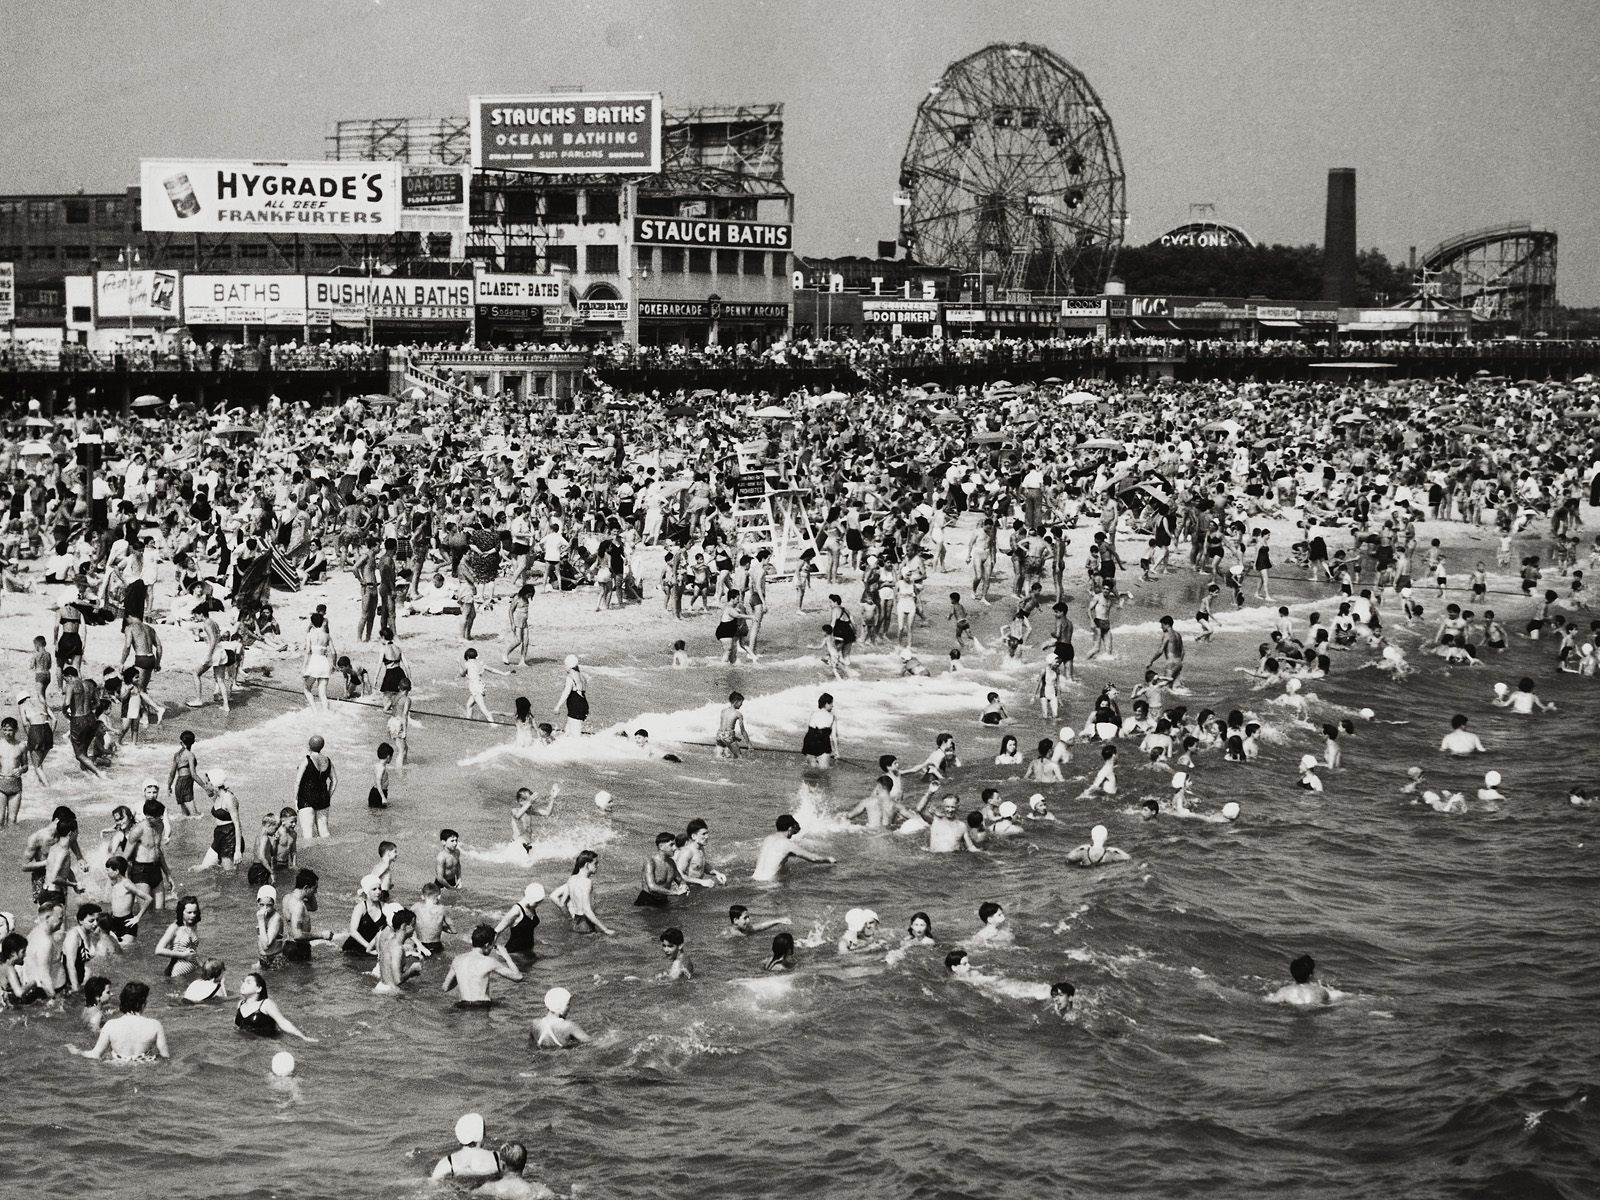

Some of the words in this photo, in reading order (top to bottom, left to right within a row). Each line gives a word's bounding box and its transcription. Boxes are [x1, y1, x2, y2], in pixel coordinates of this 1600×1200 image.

[490, 107, 576, 126] STAUCHS
[584, 105, 646, 124] BATHS
[496, 133, 553, 146] OCEAN
[563, 131, 638, 145] BATHING
[217, 171, 383, 203] HYGRADE'S
[264, 200, 285, 209] ALL
[293, 200, 328, 209] BEEF
[217, 209, 382, 224] FRANKFURTERS
[640, 220, 721, 243] STAUCH
[727, 225, 787, 246] BATHS
[1161, 234, 1228, 247] CYCLONE
[214, 283, 280, 302] BATHS
[317, 283, 406, 305] BUSHMAN
[414, 286, 469, 305] BATHS
[480, 281, 520, 296] CLARET
[528, 283, 559, 297] BATHS
[725, 305, 751, 316] PENNY
[754, 305, 785, 317] ARCADE
[1068, 300, 1101, 309] COOKS
[873, 311, 896, 322] DON
[897, 311, 930, 322] BAKER
